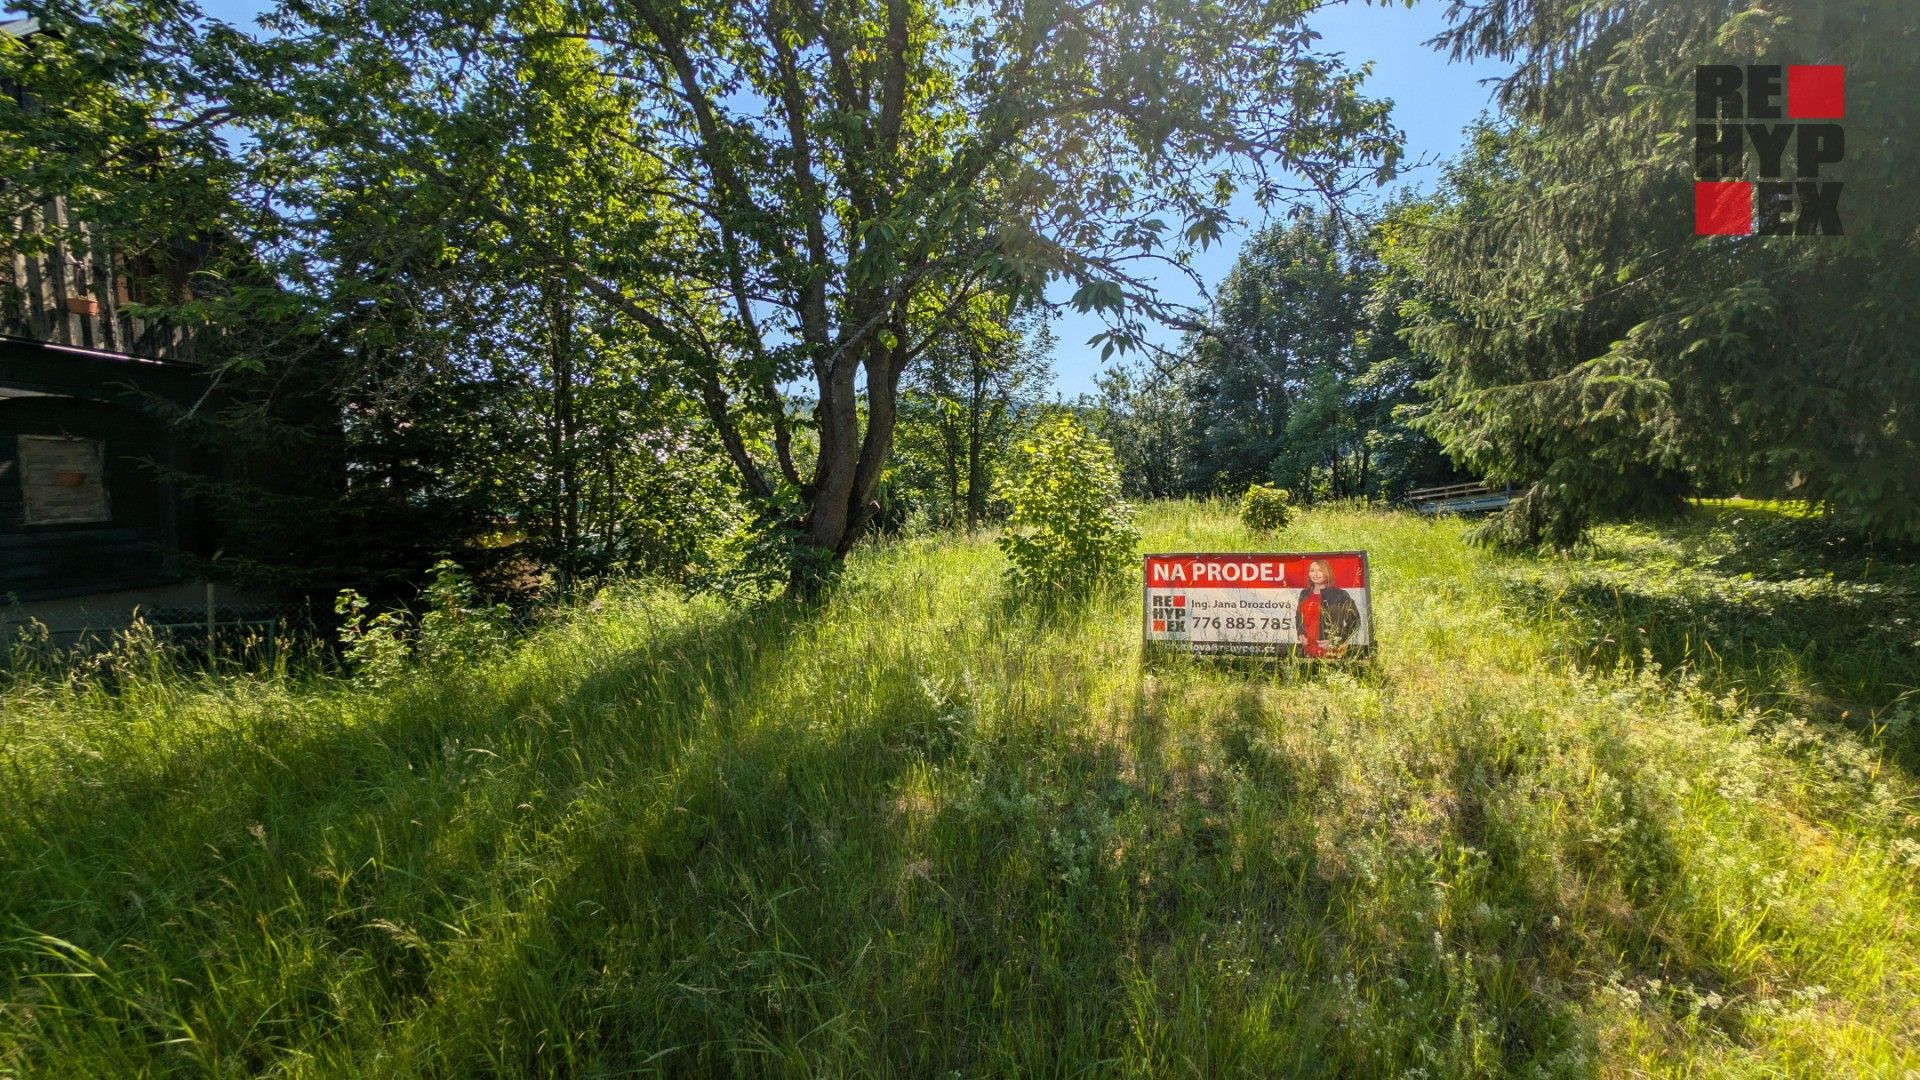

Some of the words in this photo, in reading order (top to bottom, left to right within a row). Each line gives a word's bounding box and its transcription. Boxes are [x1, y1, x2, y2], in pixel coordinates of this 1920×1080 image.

[1153, 563, 1187, 581] NA
[1192, 563, 1285, 582] PRODEJ
[1152, 595, 1172, 607] RE
[1191, 600, 1210, 610] Ing.
[1213, 600, 1237, 609] Jana
[1239, 599, 1292, 609] Drozdová
[1152, 608, 1186, 620] HYP
[1167, 620, 1186, 633] EX
[1192, 616, 1221, 629] 776
[1225, 617, 1255, 630] 885
[1260, 617, 1291, 631] 785
